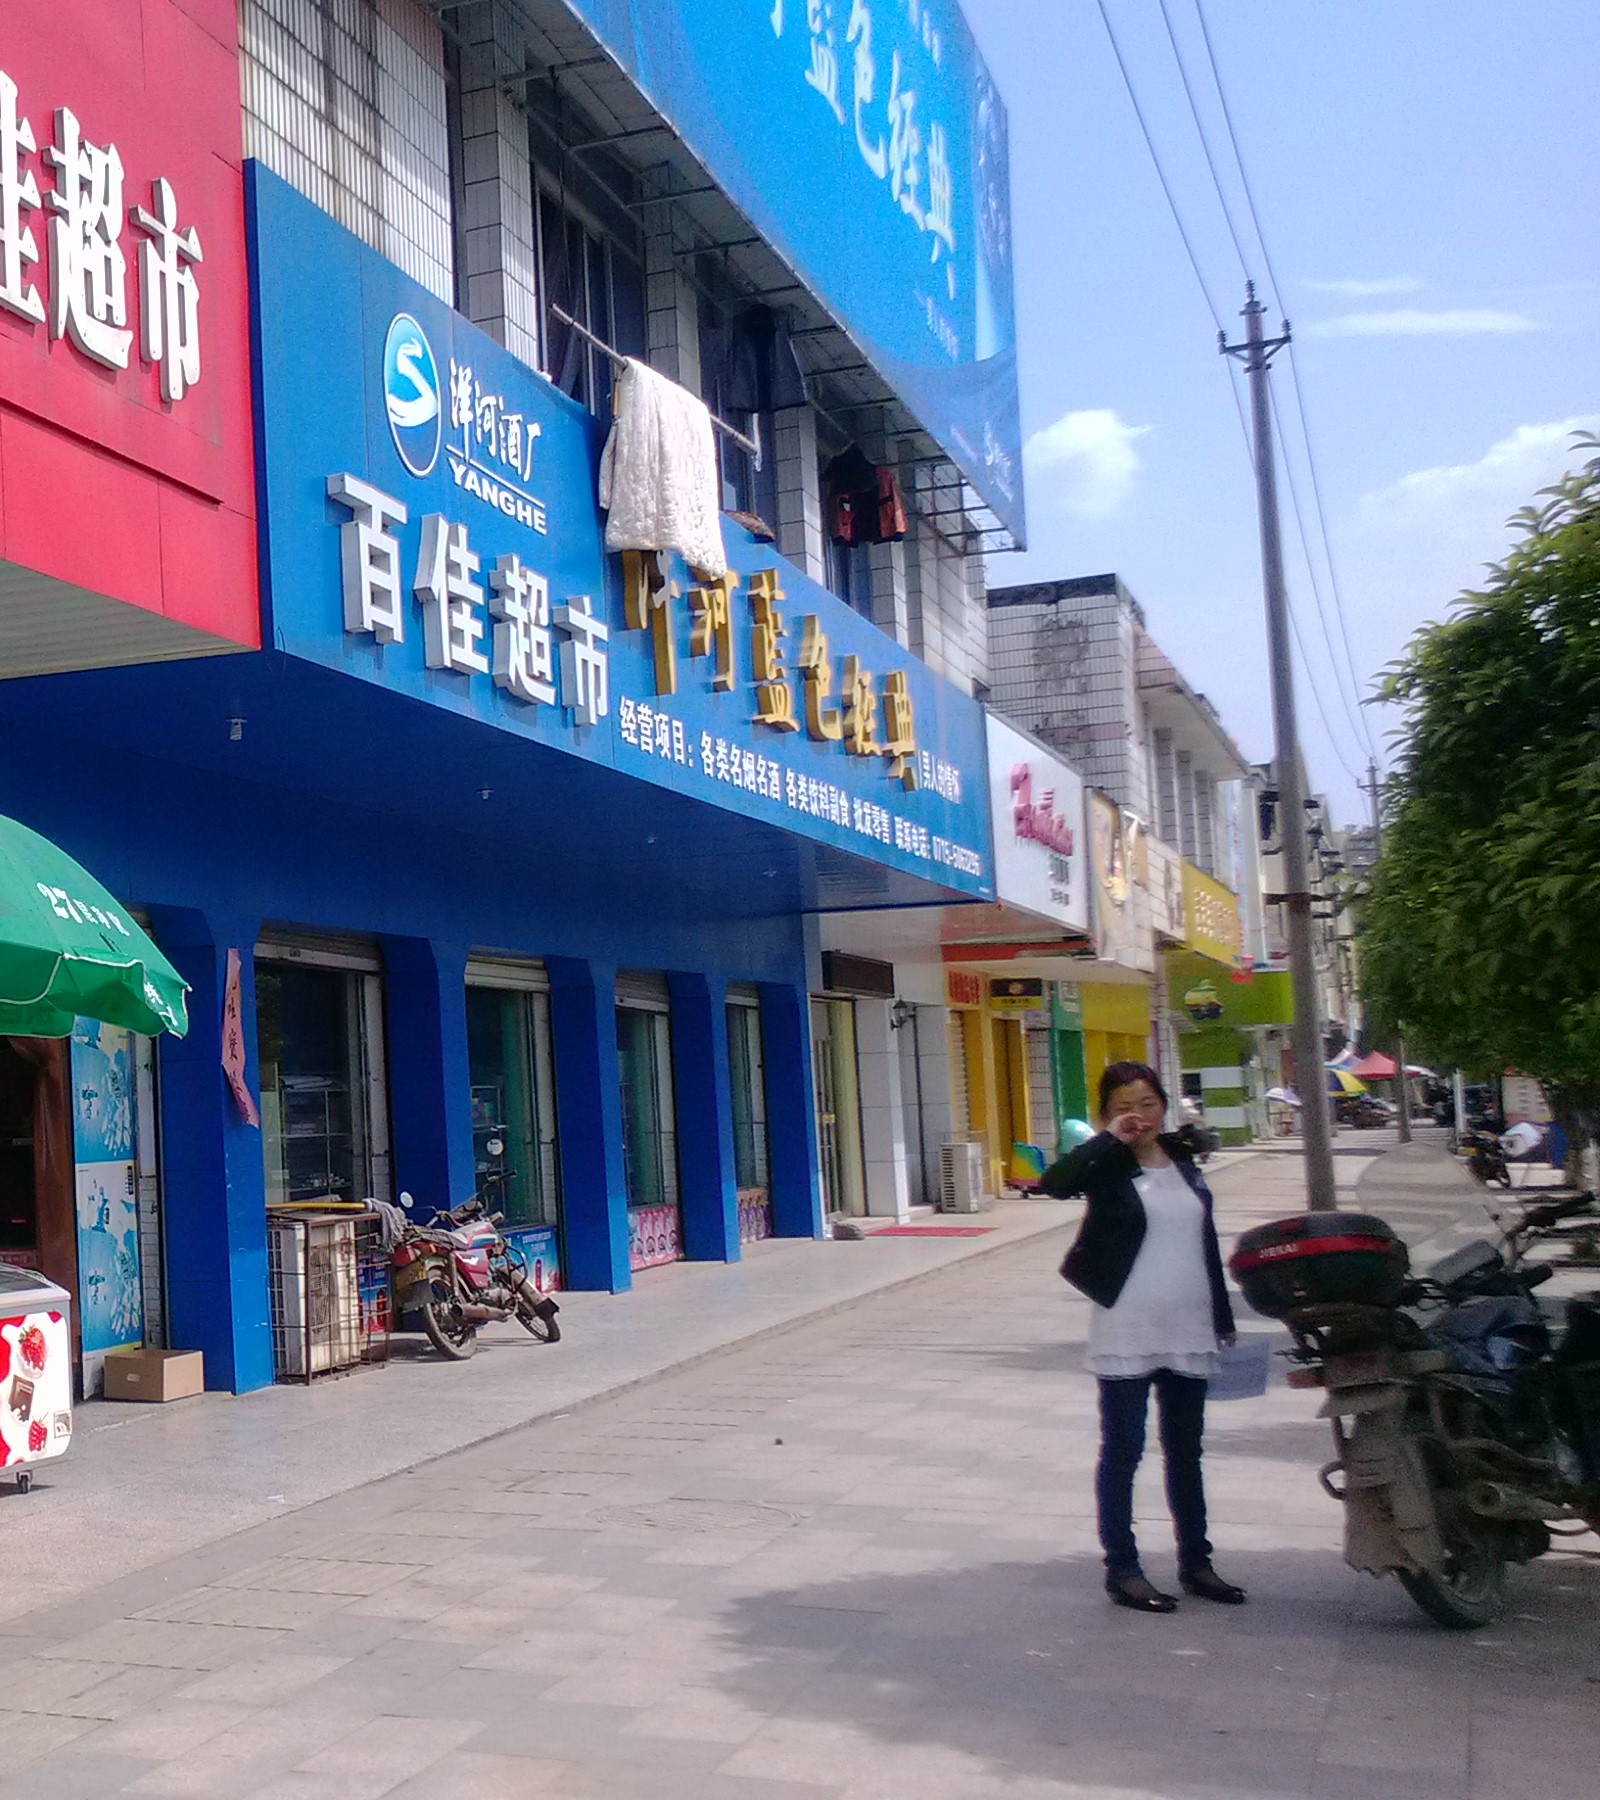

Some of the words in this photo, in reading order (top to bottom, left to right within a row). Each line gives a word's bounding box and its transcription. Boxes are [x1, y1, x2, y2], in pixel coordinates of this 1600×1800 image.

[450, 357, 542, 482] 洋河酒厂
[448, 456, 548, 536] YANGHE
[327, 472, 609, 727] 百佳超市
[36, 882, 130, 937] 27层净化
